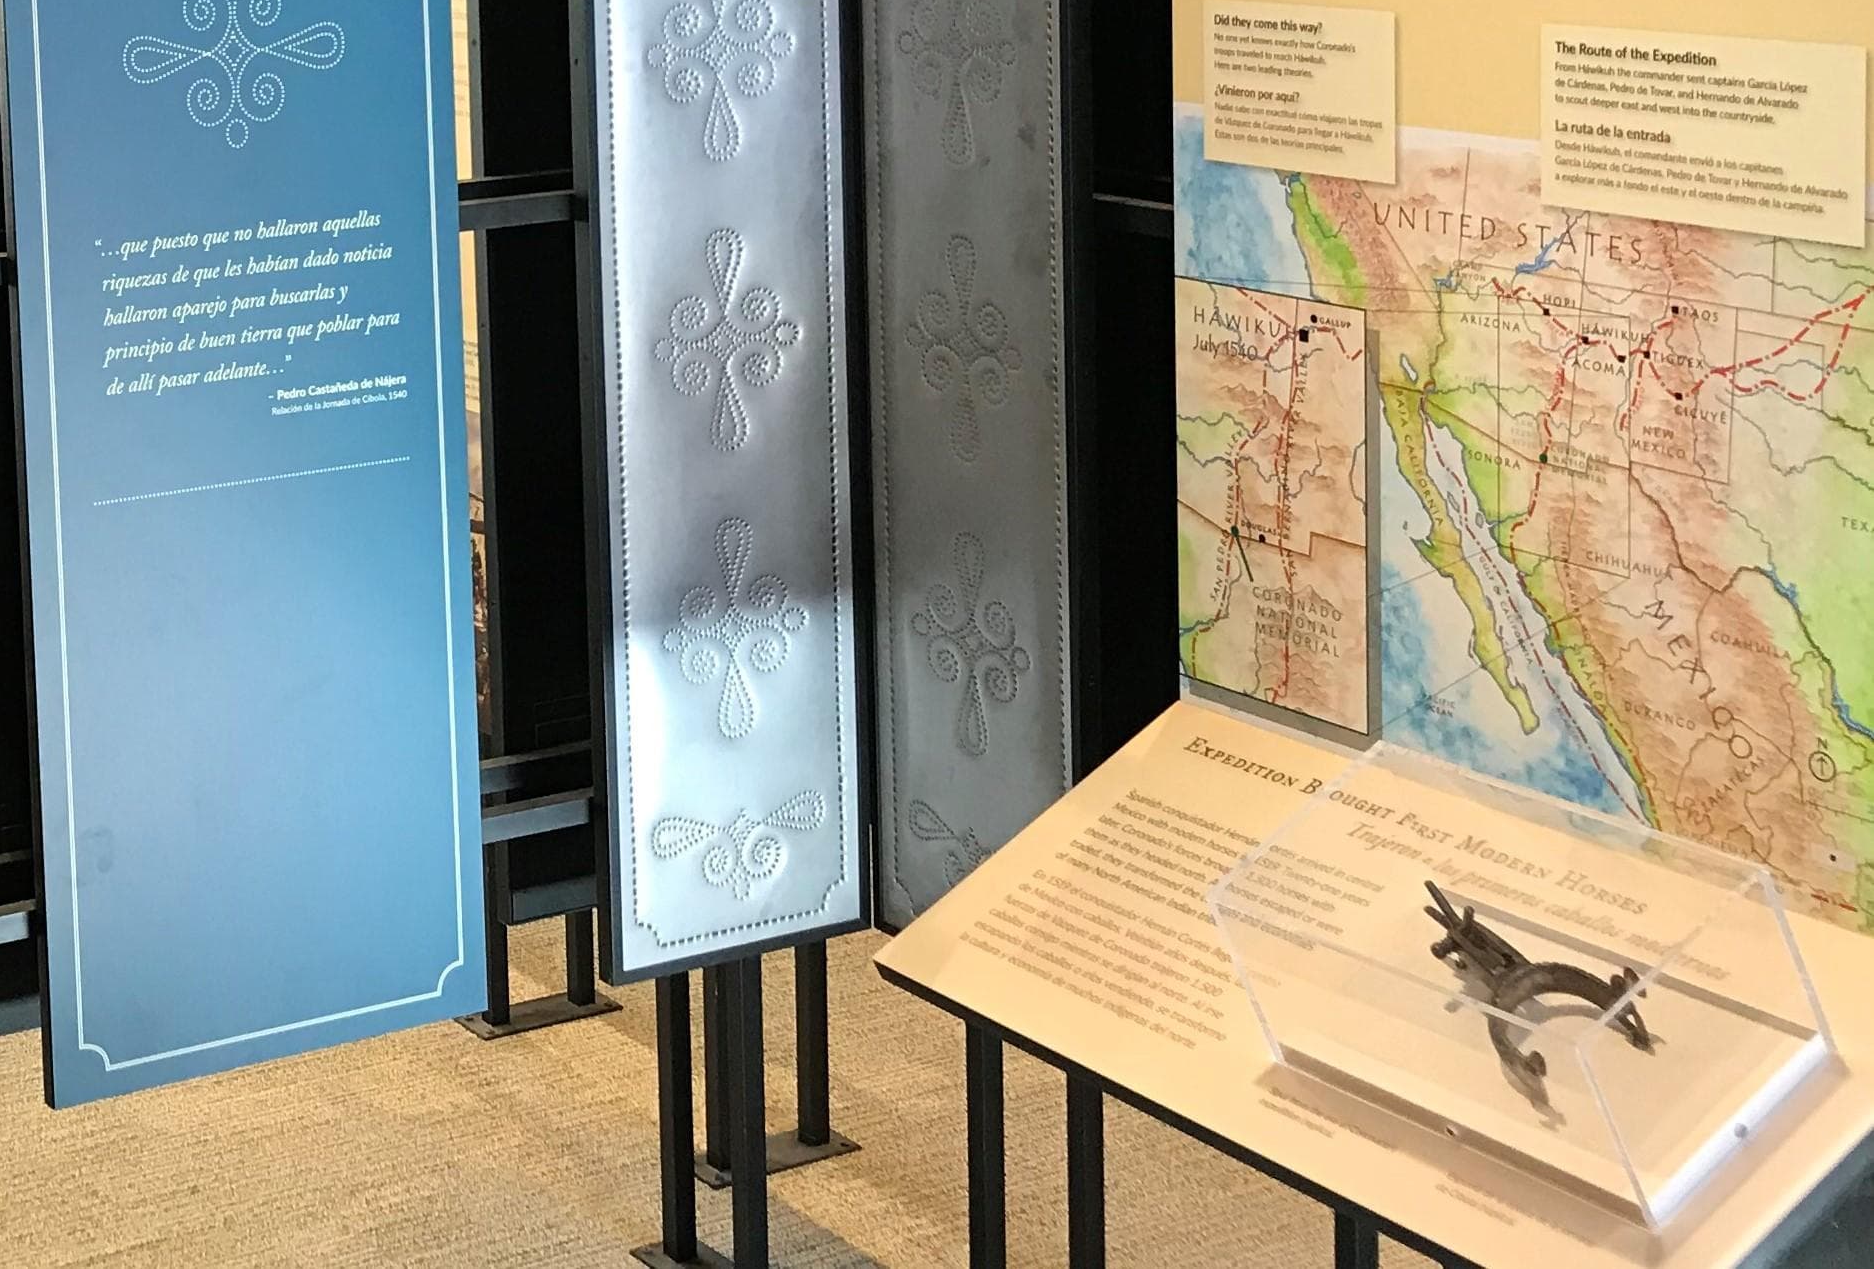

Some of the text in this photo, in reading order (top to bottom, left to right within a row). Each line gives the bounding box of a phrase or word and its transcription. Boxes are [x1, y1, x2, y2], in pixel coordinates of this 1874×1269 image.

[1213, 13, 1323, 36] Did they come this way?
[1555, 40, 1717, 67] The Route of the Expedition
[1214, 83, 1301, 105] ¿Vinieron por aquí?
[1554, 119, 1672, 145] La ruta de la entrada
[150, 232, 200, 259] puesto
[202, 230, 230, 252] que
[233, 228, 253, 242] no
[256, 218, 319, 240] hallaron
[322, 209, 382, 238] aquellas
[1374, 202, 1644, 265] UNITED STATES
[1543, 294, 1577, 310] HOPI
[1319, 317, 1352, 330] GALLUP
[1460, 313, 1521, 333] ARIZONA
[1680, 306, 1720, 323] TAOS
[1192, 334, 1258, 362] July 1540
[1643, 425, 1675, 441] NEW
[1467, 448, 1522, 472] SONORA
[1631, 439, 1688, 461] MEXICO
[1841, 516, 1874, 533] TEX
[1585, 550, 1675, 582] CHIHUAHUA
[1252, 585, 1344, 622] CORONADO
[1256, 604, 1339, 640] NATIONAL
[1255, 621, 1340, 658] MEMORIAL
